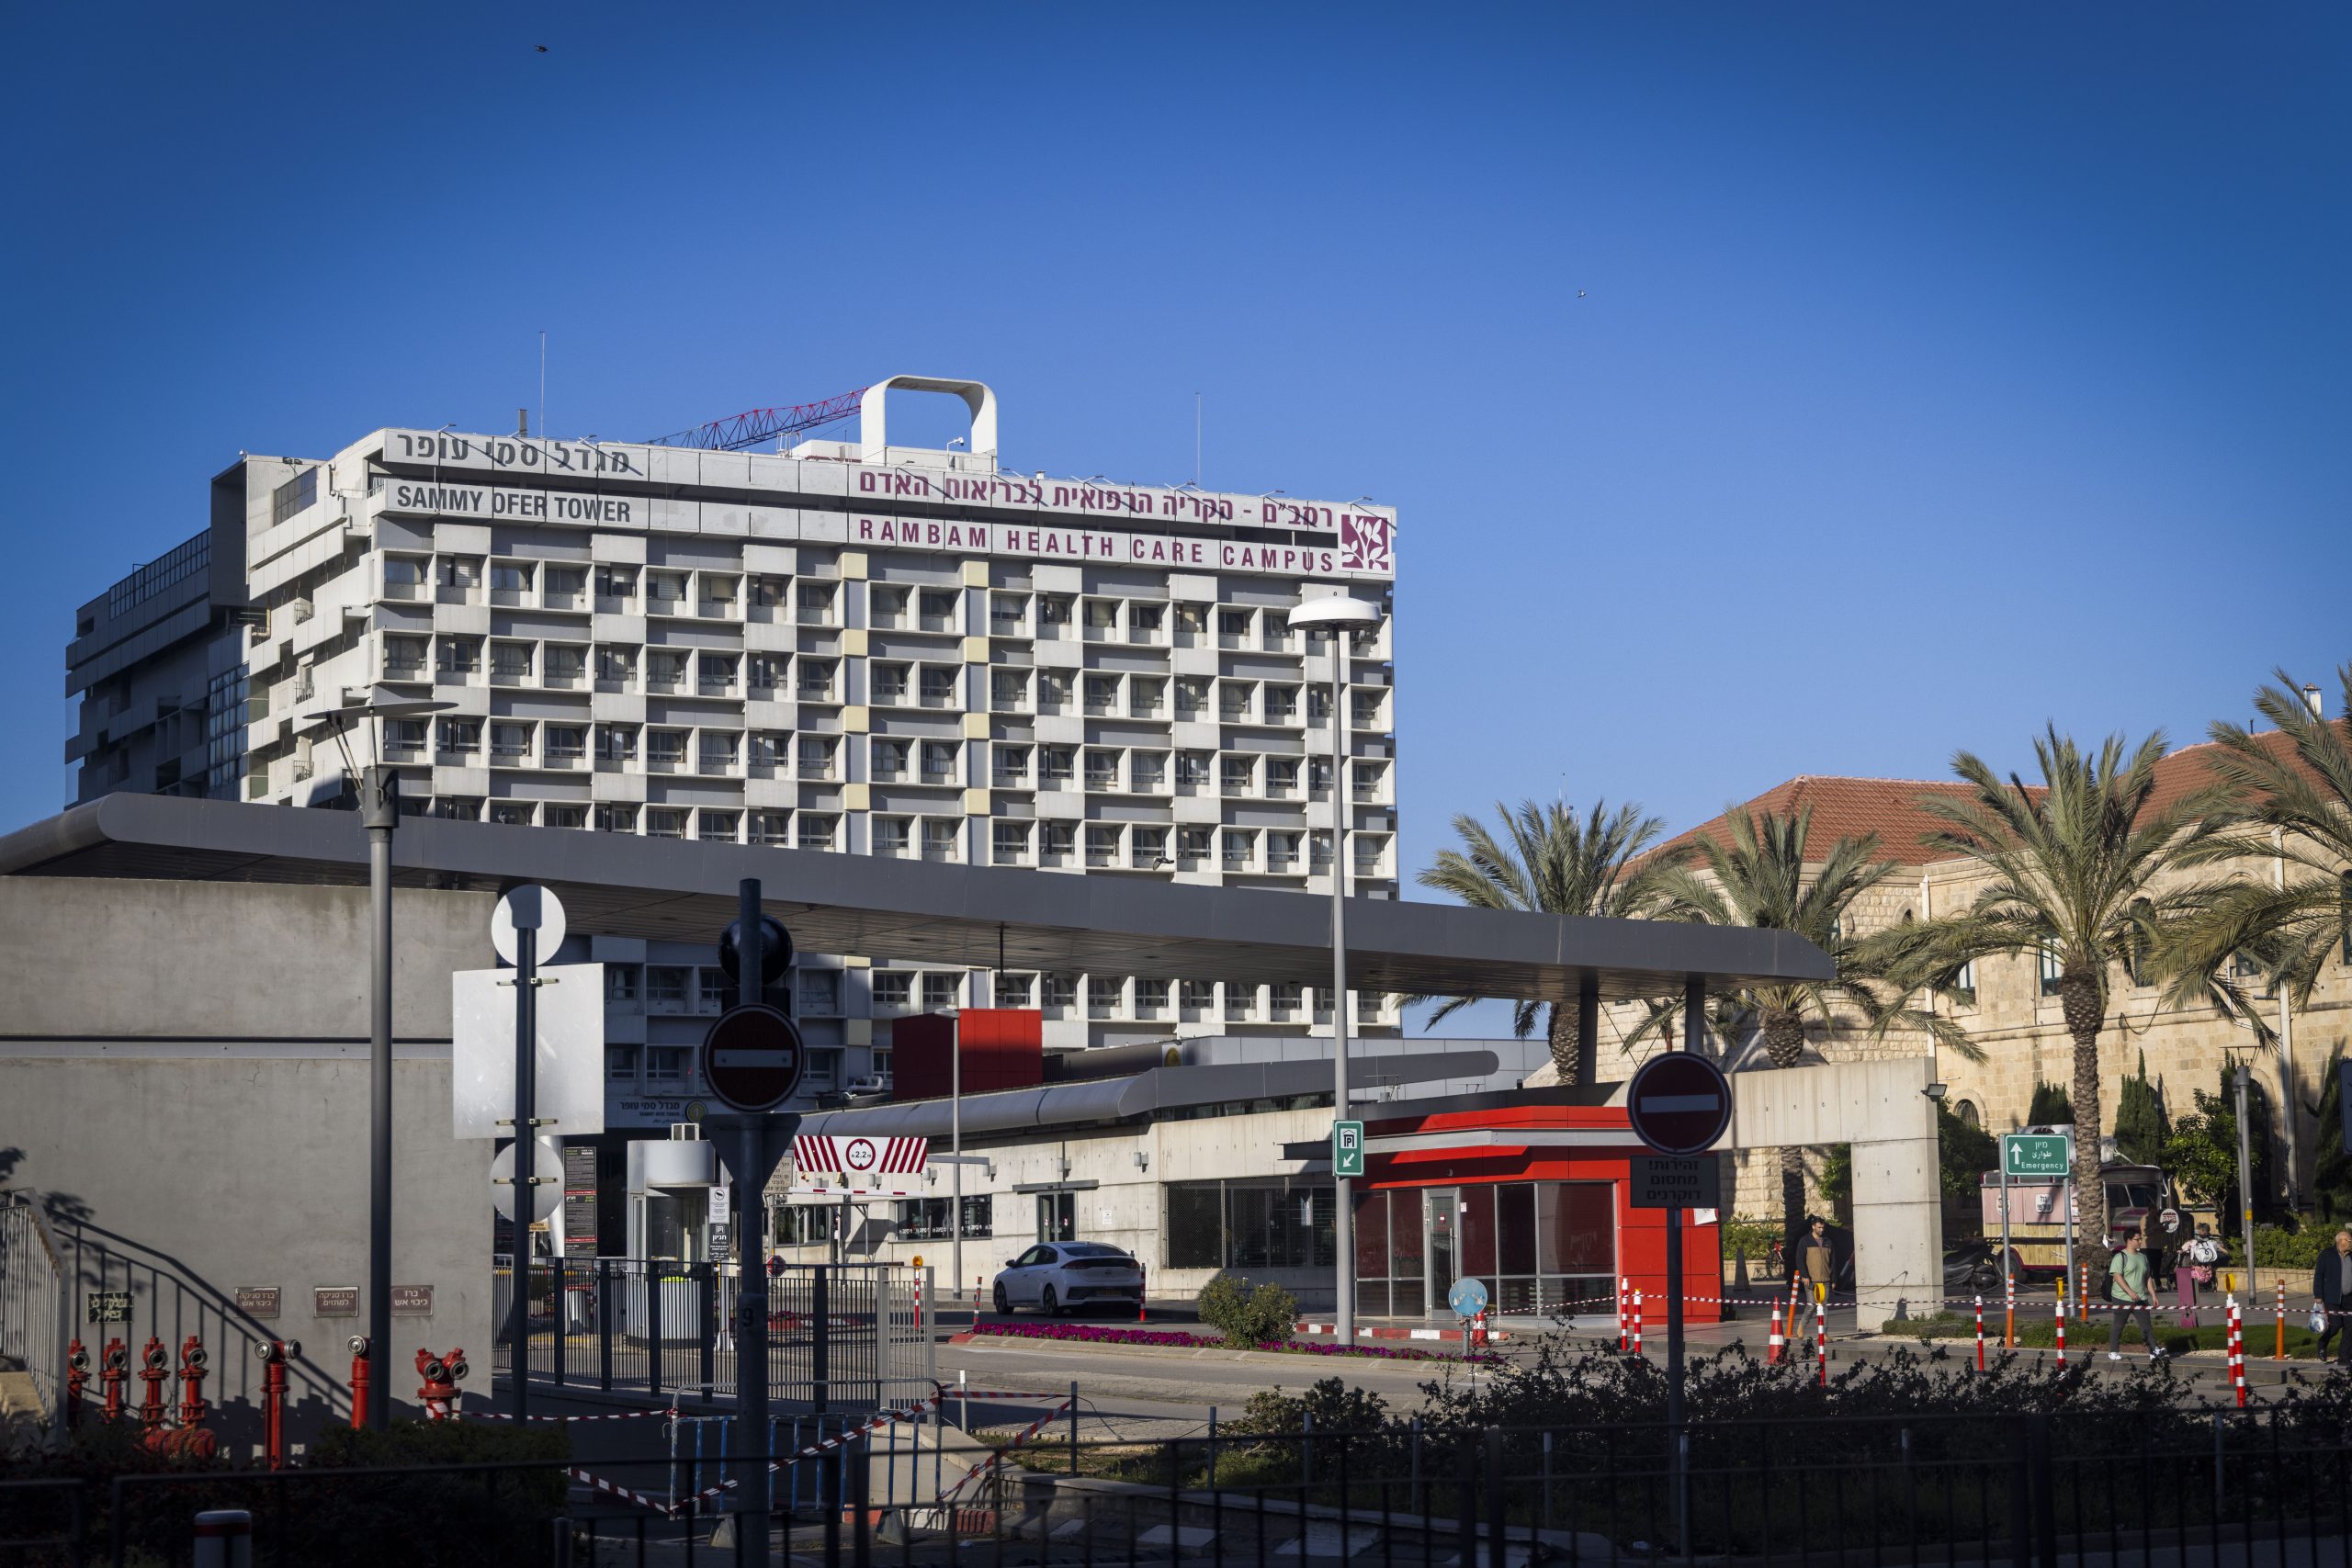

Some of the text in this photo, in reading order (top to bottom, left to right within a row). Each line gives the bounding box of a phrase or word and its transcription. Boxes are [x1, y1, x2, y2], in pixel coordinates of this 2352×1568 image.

[398, 434, 630, 472] מגדל סמי עופר
[859, 471, 929, 497] האדם
[944, 477, 1044, 504] לבריאות
[397, 485, 630, 523] SAMMY OFER TOWER
[1053, 486, 1152, 513] הרפואית
[1163, 495, 1233, 524] הקריה
[860, 519, 1333, 572] RAMBAM HEALTH CARE CAMPUS
[619, 1100, 680, 1110] מגדל סמי עופר
[2035, 1141, 2048, 1150] מיון
[1648, 1160, 1699, 1170] זהירות!
[2021, 1162, 2064, 1170] Emergency
[1650, 1175, 1698, 1185] מחסום
[1646, 1190, 1702, 1202] דוקרנים
[239, 1292, 262, 1301] סניקה
[319, 1292, 340, 1301] סניקה
